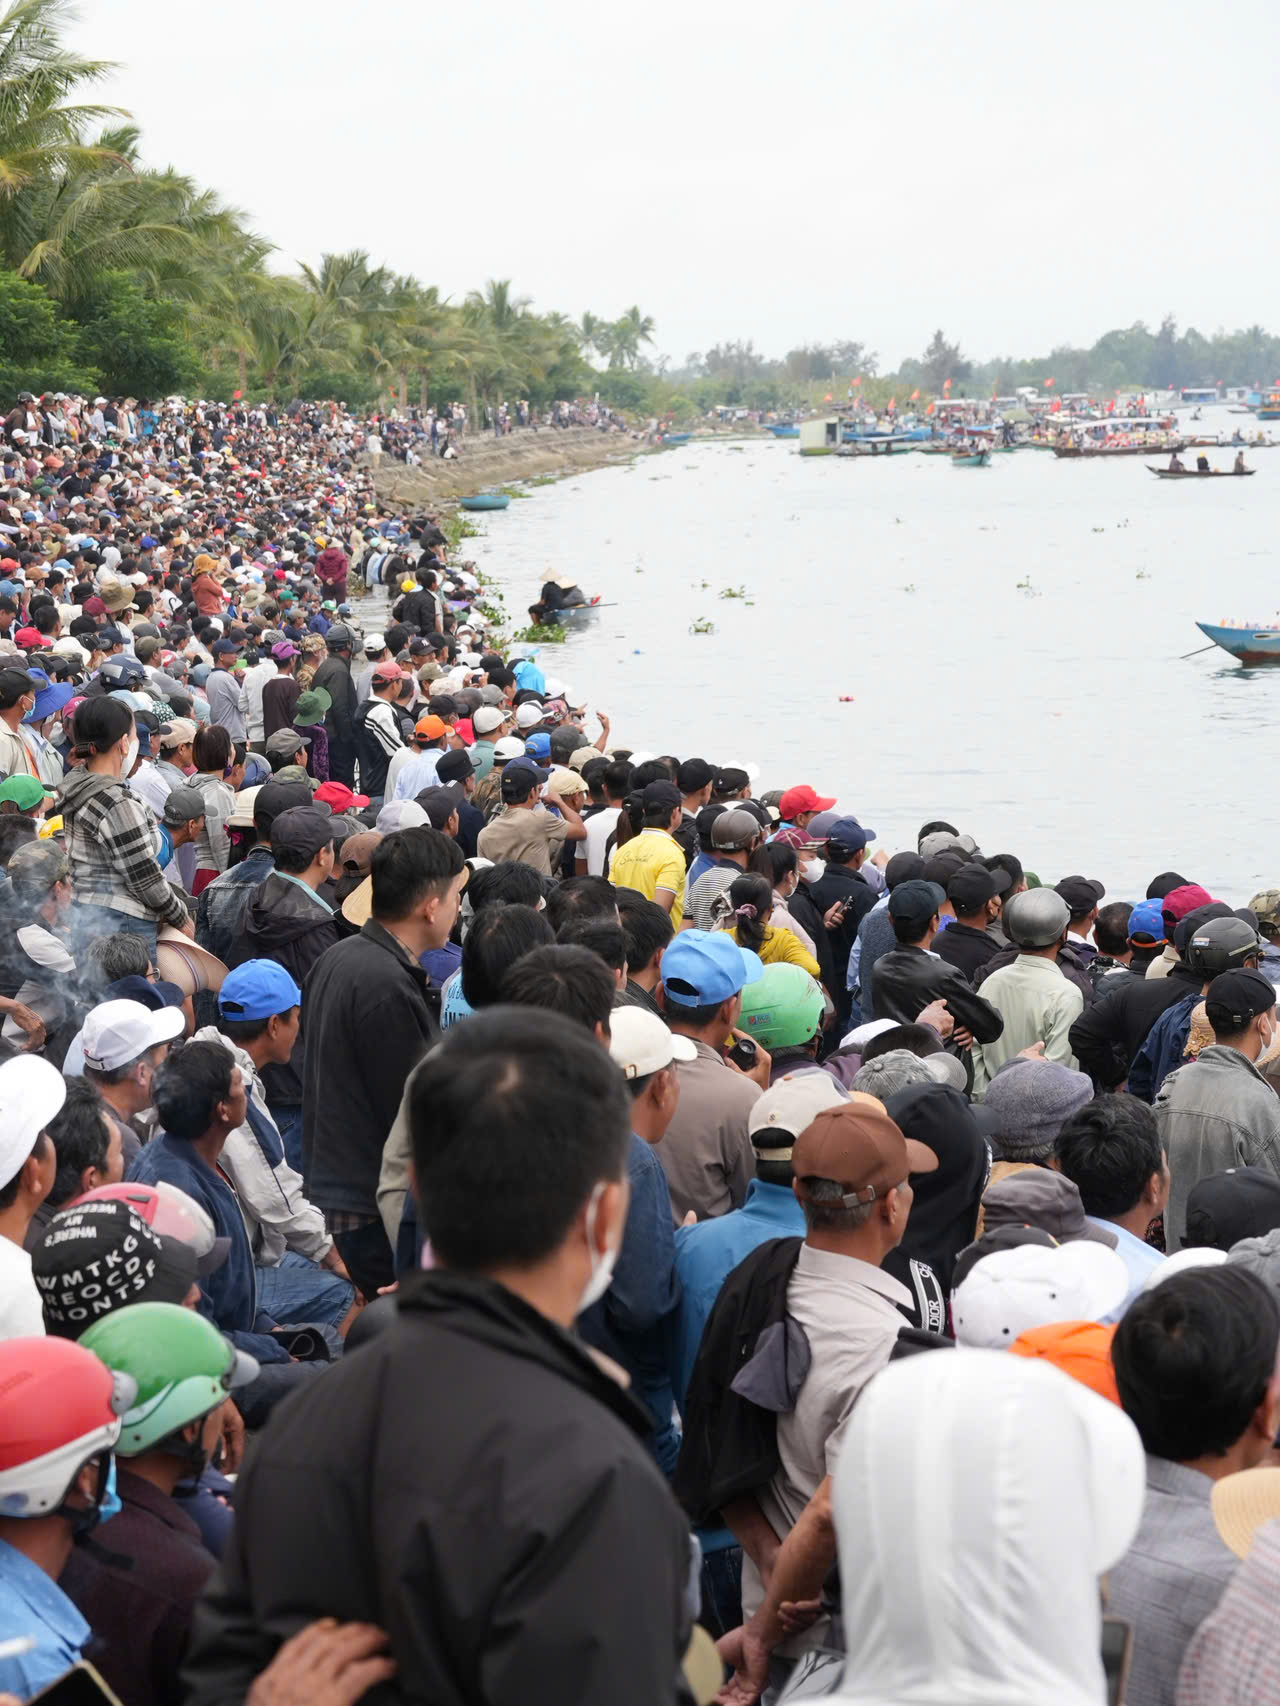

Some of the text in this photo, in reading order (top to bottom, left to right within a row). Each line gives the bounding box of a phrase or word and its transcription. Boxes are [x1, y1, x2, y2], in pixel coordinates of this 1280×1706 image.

[63, 1215, 84, 1227] MY
[44, 1226, 97, 1247] WHERE'S
[928, 1300, 941, 1327] DIOR
